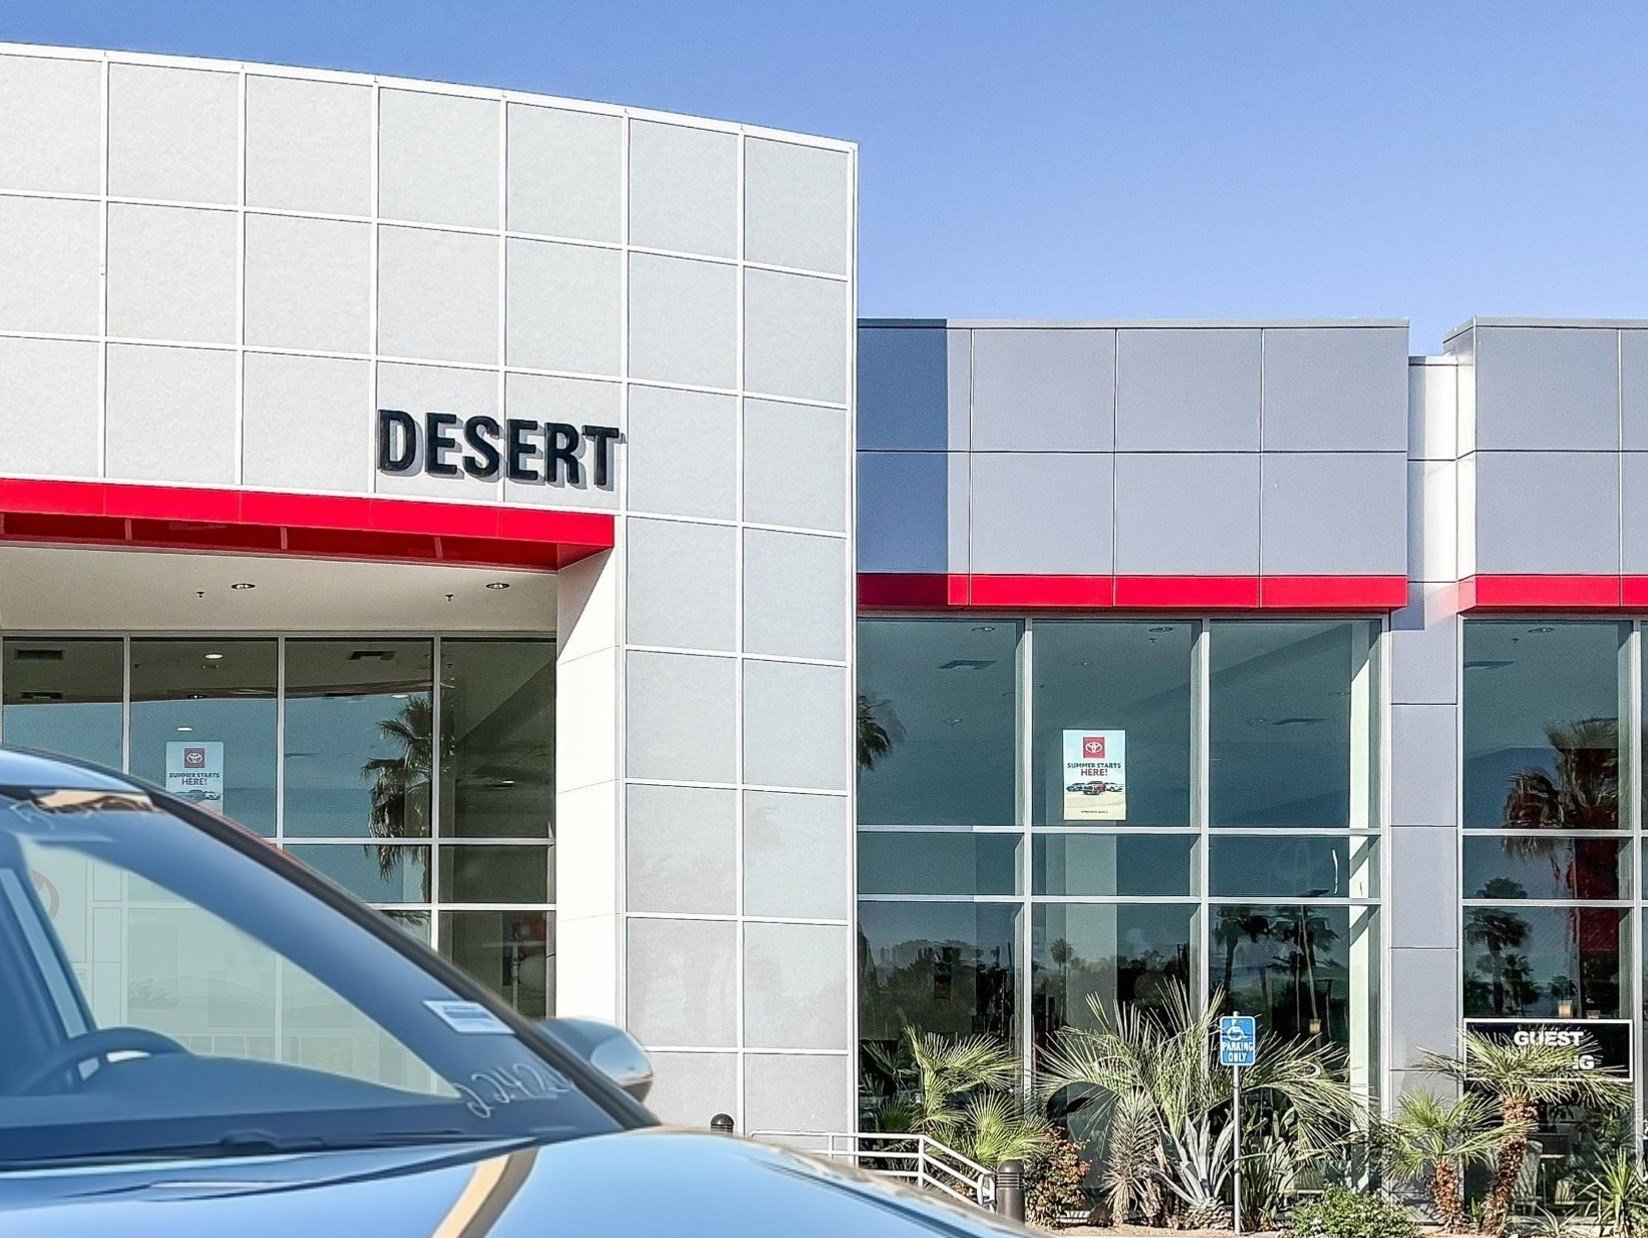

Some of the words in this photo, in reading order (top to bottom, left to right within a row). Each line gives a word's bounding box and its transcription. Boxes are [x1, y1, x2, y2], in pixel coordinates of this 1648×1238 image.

[377, 409, 620, 487] DESERT
[1513, 1031, 1585, 1047] GUEST
[1222, 1041, 1254, 1052] PARKING
[1228, 1052, 1248, 1062] ONLY
